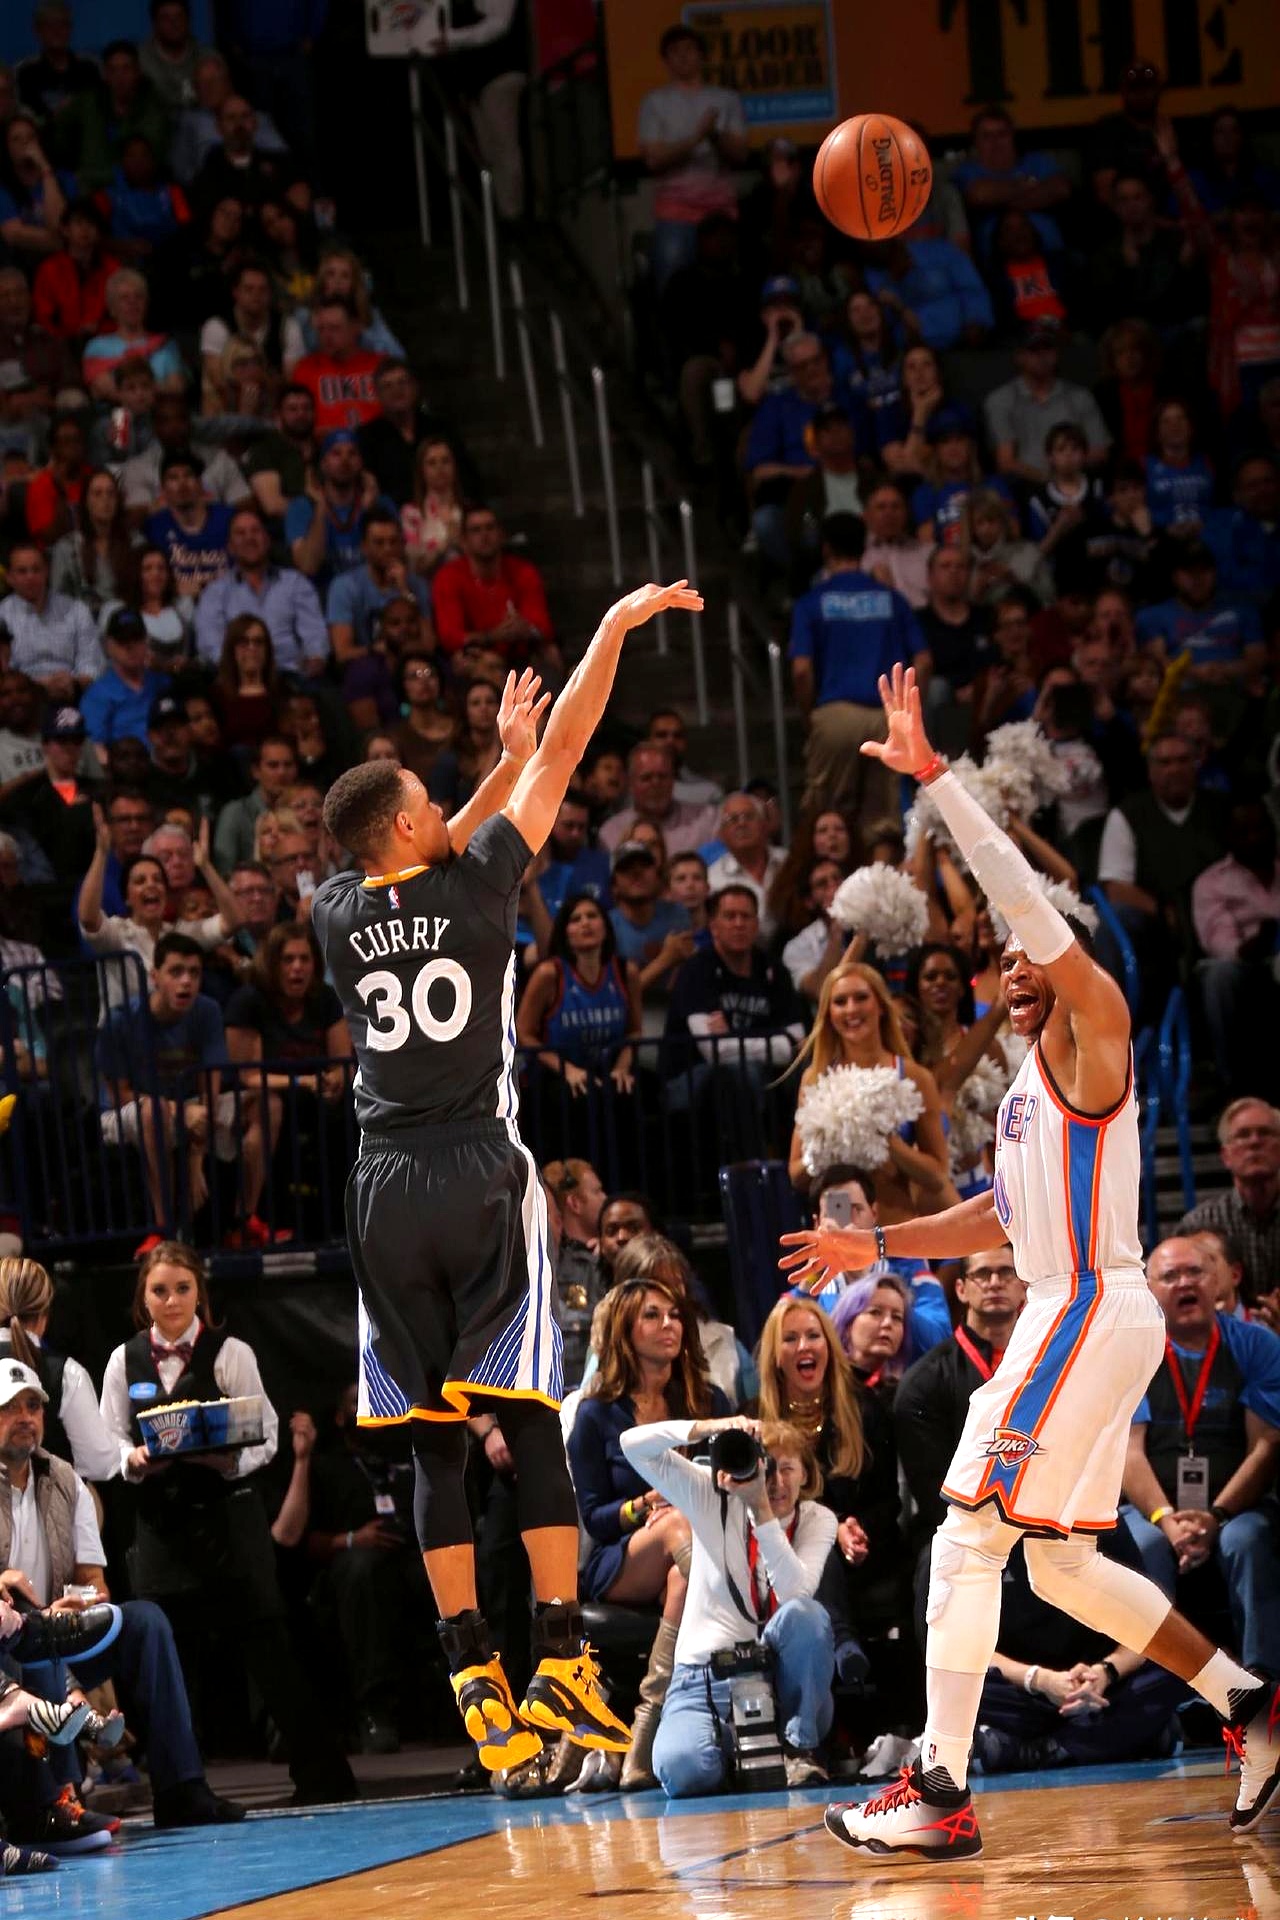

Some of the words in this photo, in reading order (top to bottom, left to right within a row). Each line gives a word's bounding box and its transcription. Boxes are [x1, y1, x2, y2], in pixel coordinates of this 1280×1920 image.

[349, 916, 450, 963] CURRY
[354, 957, 473, 1052] 30
[148, 1411, 188, 1433] THUNDER
[987, 1438, 1028, 1454] OKC
